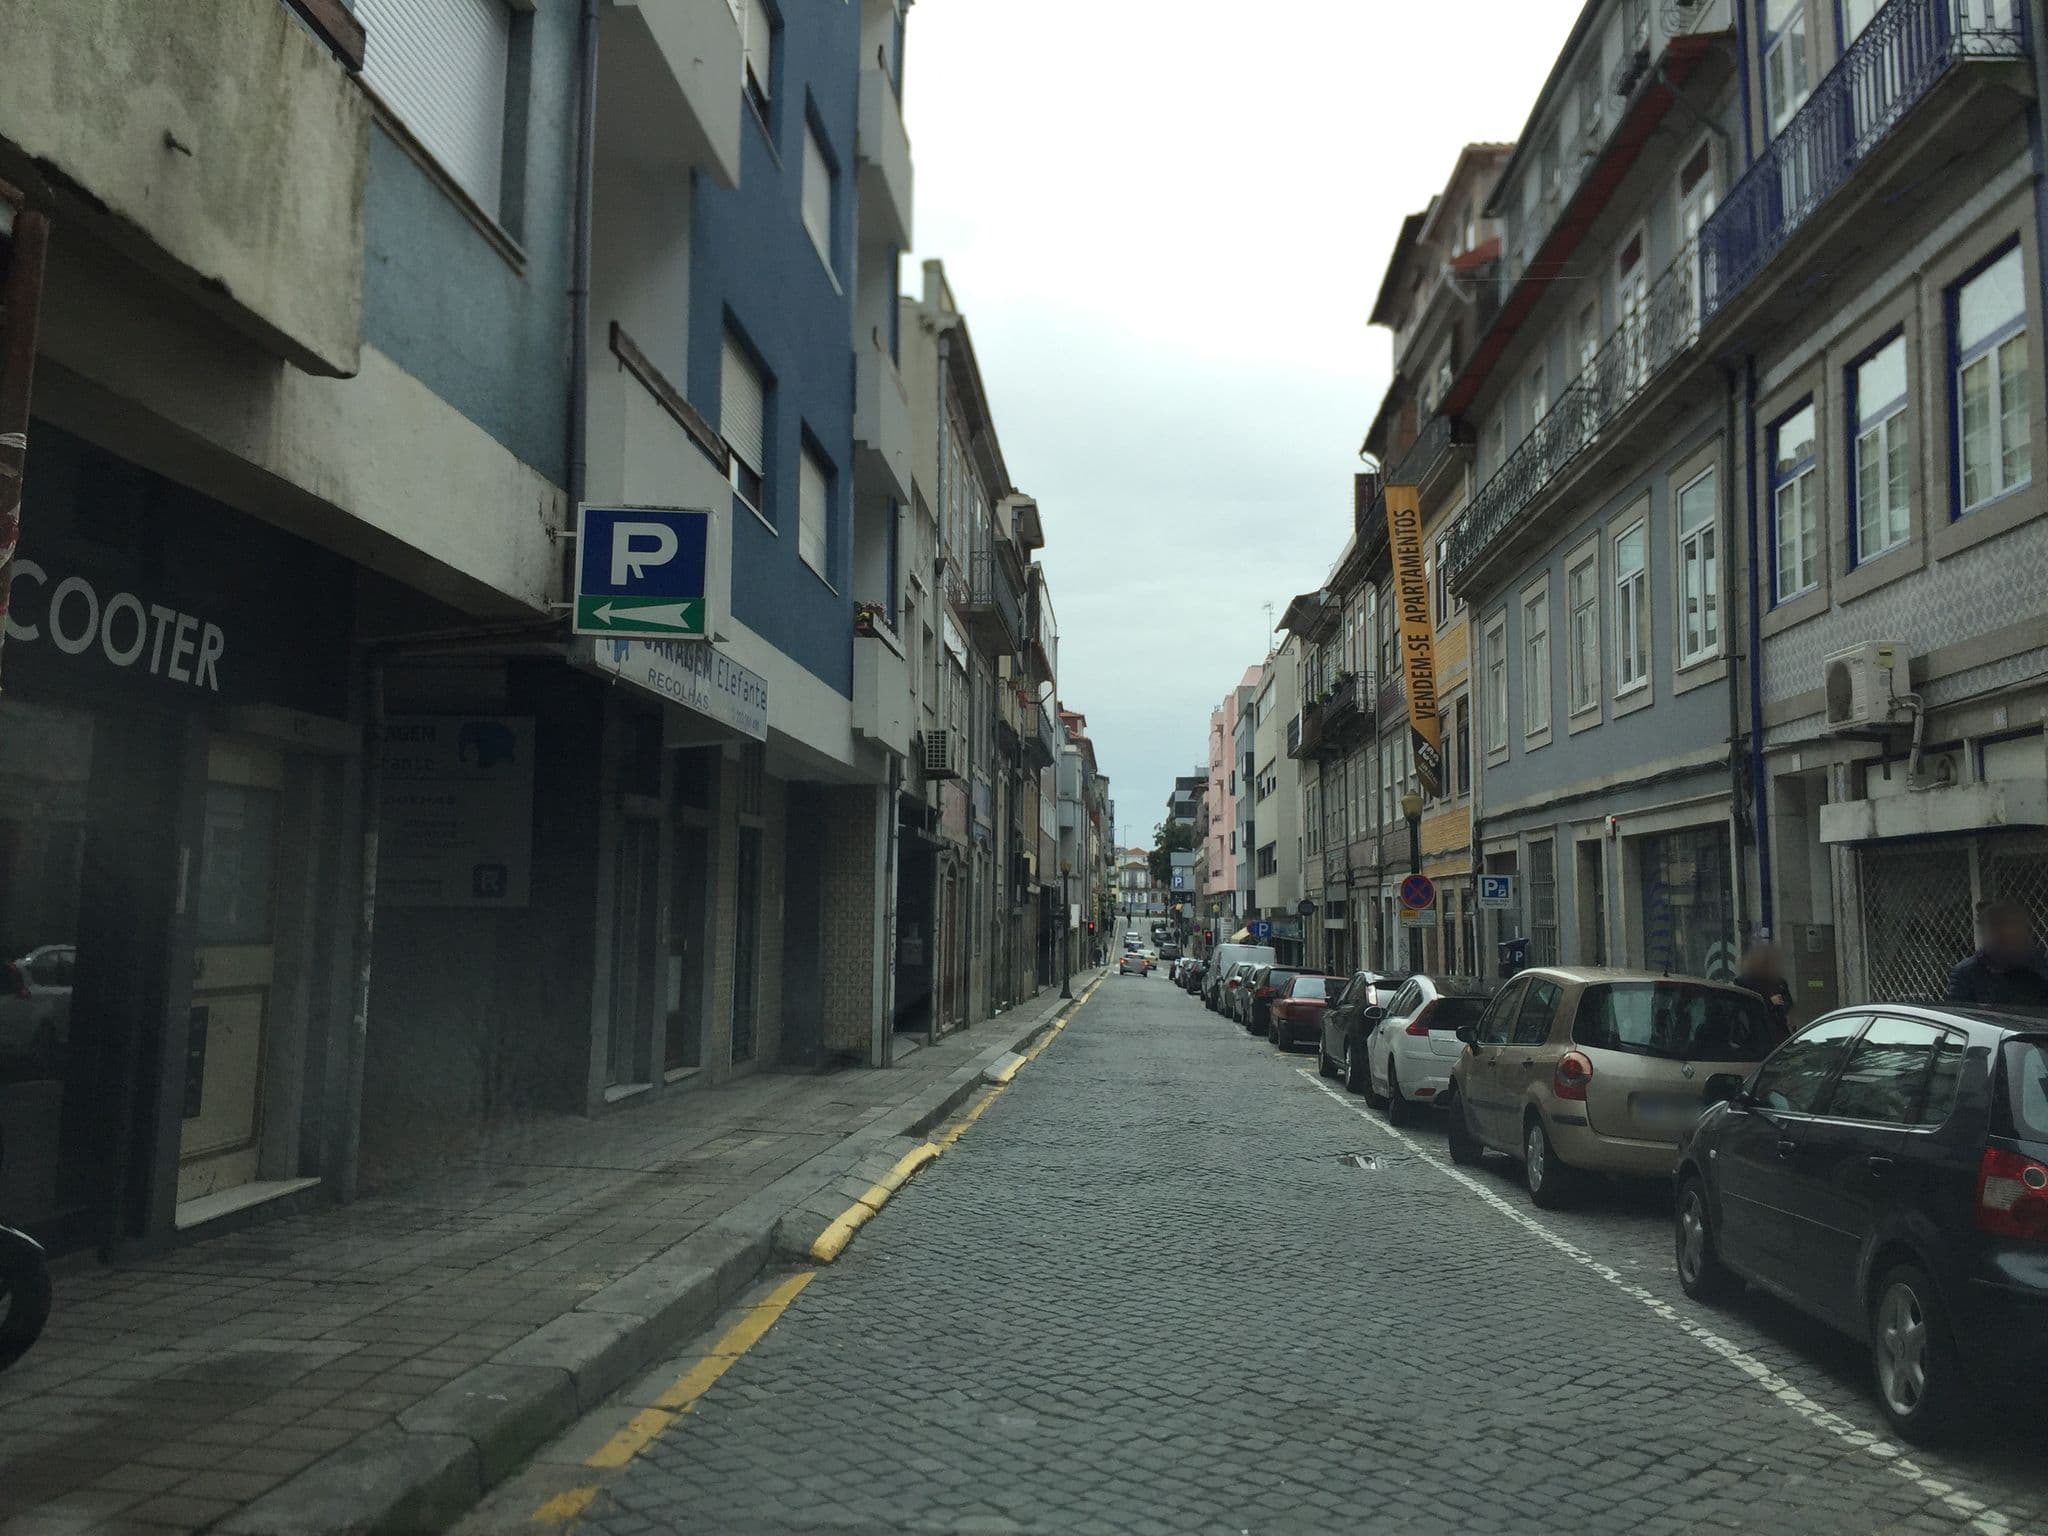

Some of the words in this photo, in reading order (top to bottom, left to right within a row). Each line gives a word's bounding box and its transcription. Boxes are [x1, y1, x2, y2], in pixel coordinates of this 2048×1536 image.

[1393, 508, 1429, 624] APARTAMENTOS
[5, 559, 225, 692] COOTER
[648, 668, 710, 711] RECOLHAS
[717, 657, 768, 711] Elefante
[1407, 633, 1436, 721] VENDEM-SE
[1484, 879, 1499, 897] P
[1258, 923, 1269, 937] P
[1515, 951, 1524, 962] P
